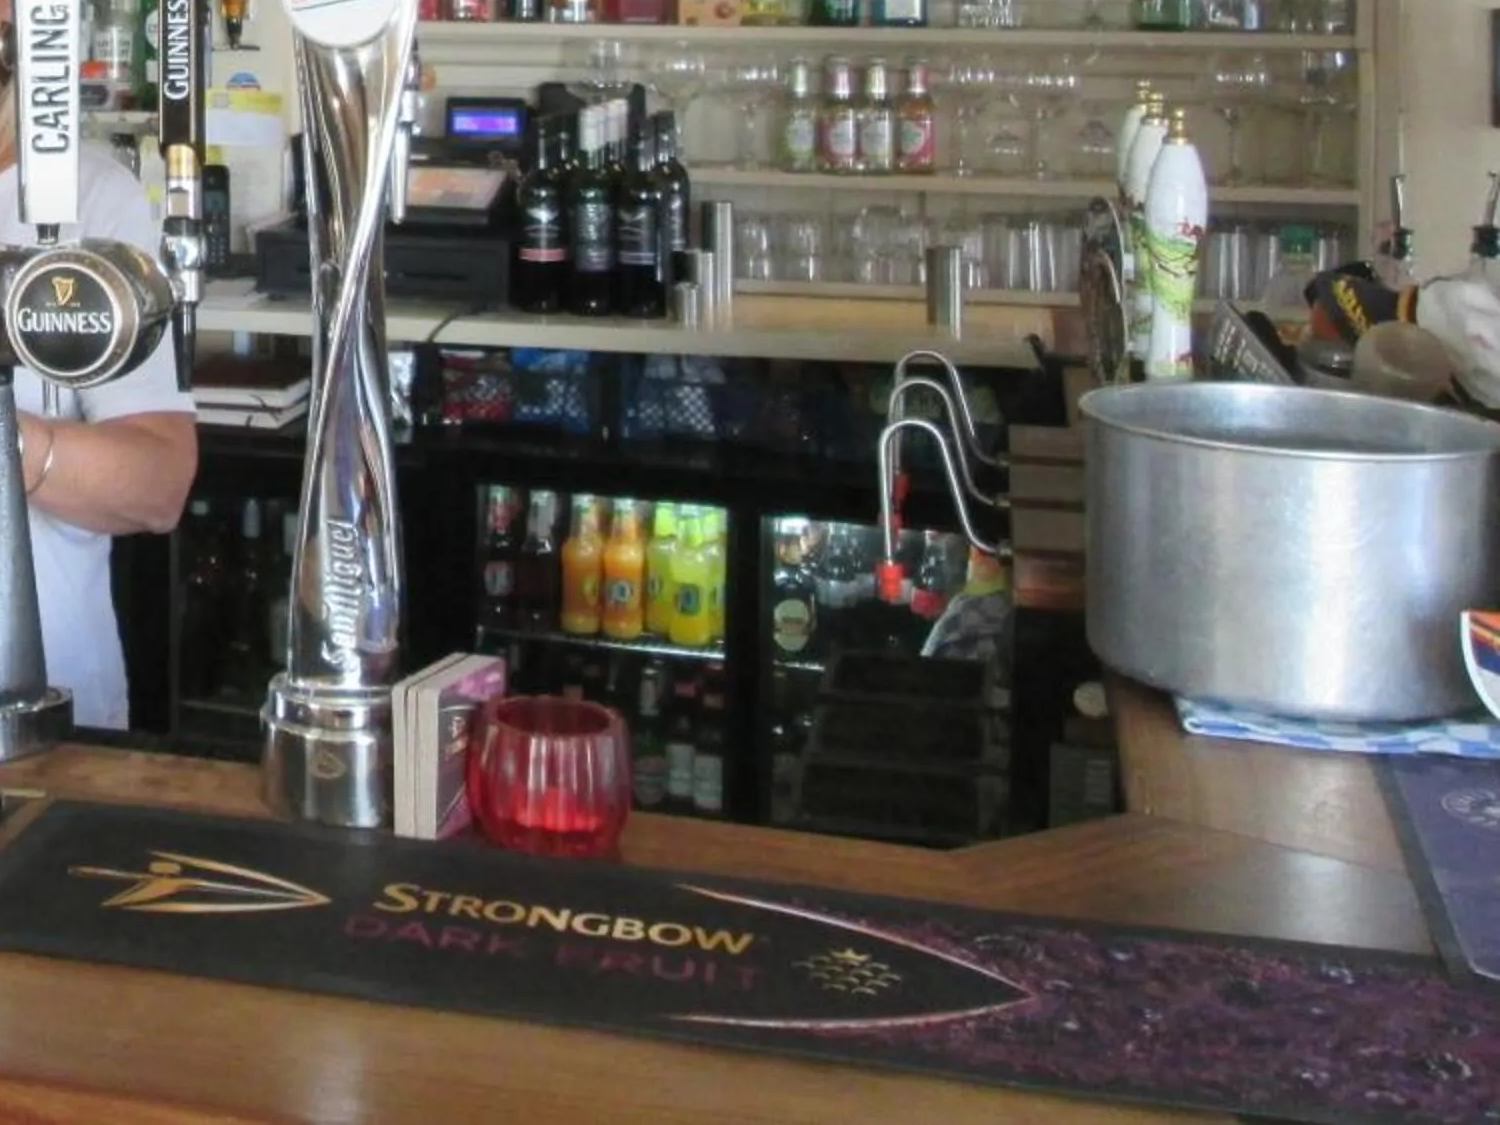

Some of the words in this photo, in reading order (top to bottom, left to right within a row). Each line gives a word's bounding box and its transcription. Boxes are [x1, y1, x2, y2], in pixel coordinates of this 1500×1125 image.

[30, 3, 70, 155] CARLING
[16, 308, 112, 334] GUINNESS
[343, 915, 525, 955] DARK
[555, 942, 762, 990] FRUIT
[372, 882, 756, 955] STRONGBOW
